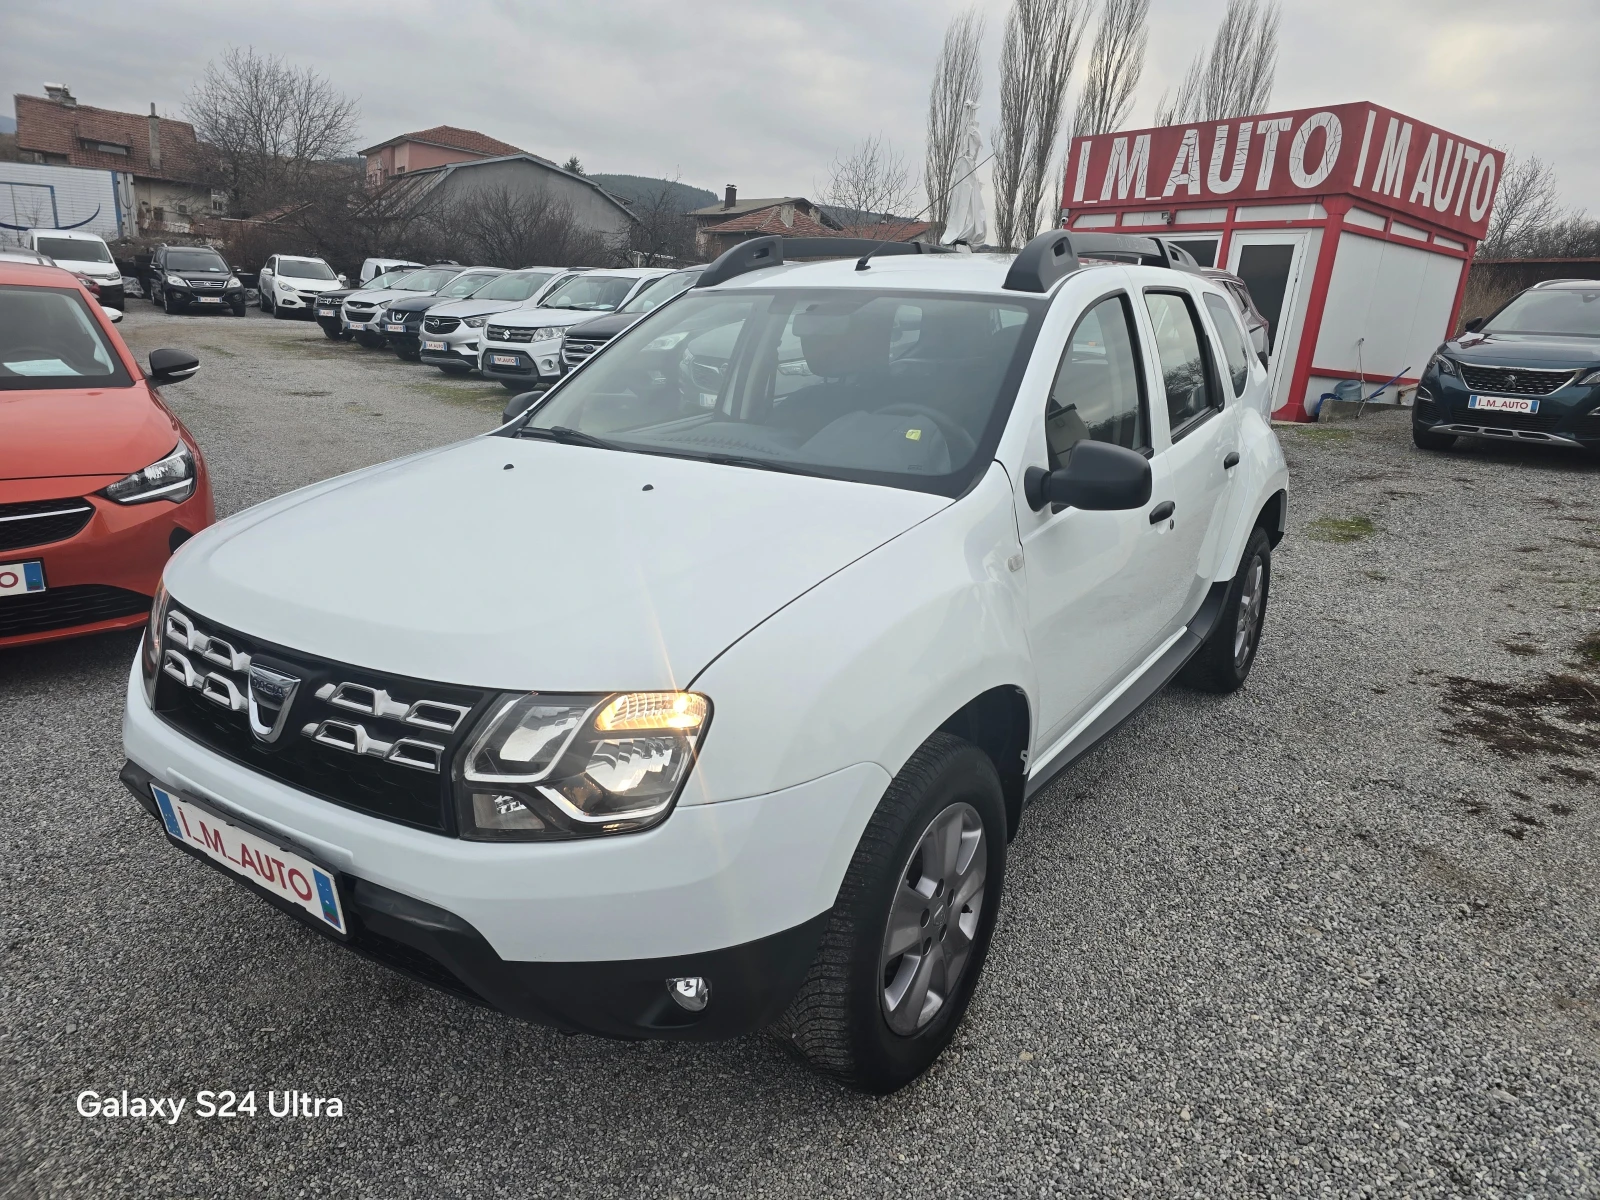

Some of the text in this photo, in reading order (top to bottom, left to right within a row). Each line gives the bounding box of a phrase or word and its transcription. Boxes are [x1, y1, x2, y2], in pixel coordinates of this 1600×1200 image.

[1353, 110, 1496, 223] I M AUTO
[252, 679, 284, 697] DACIA
